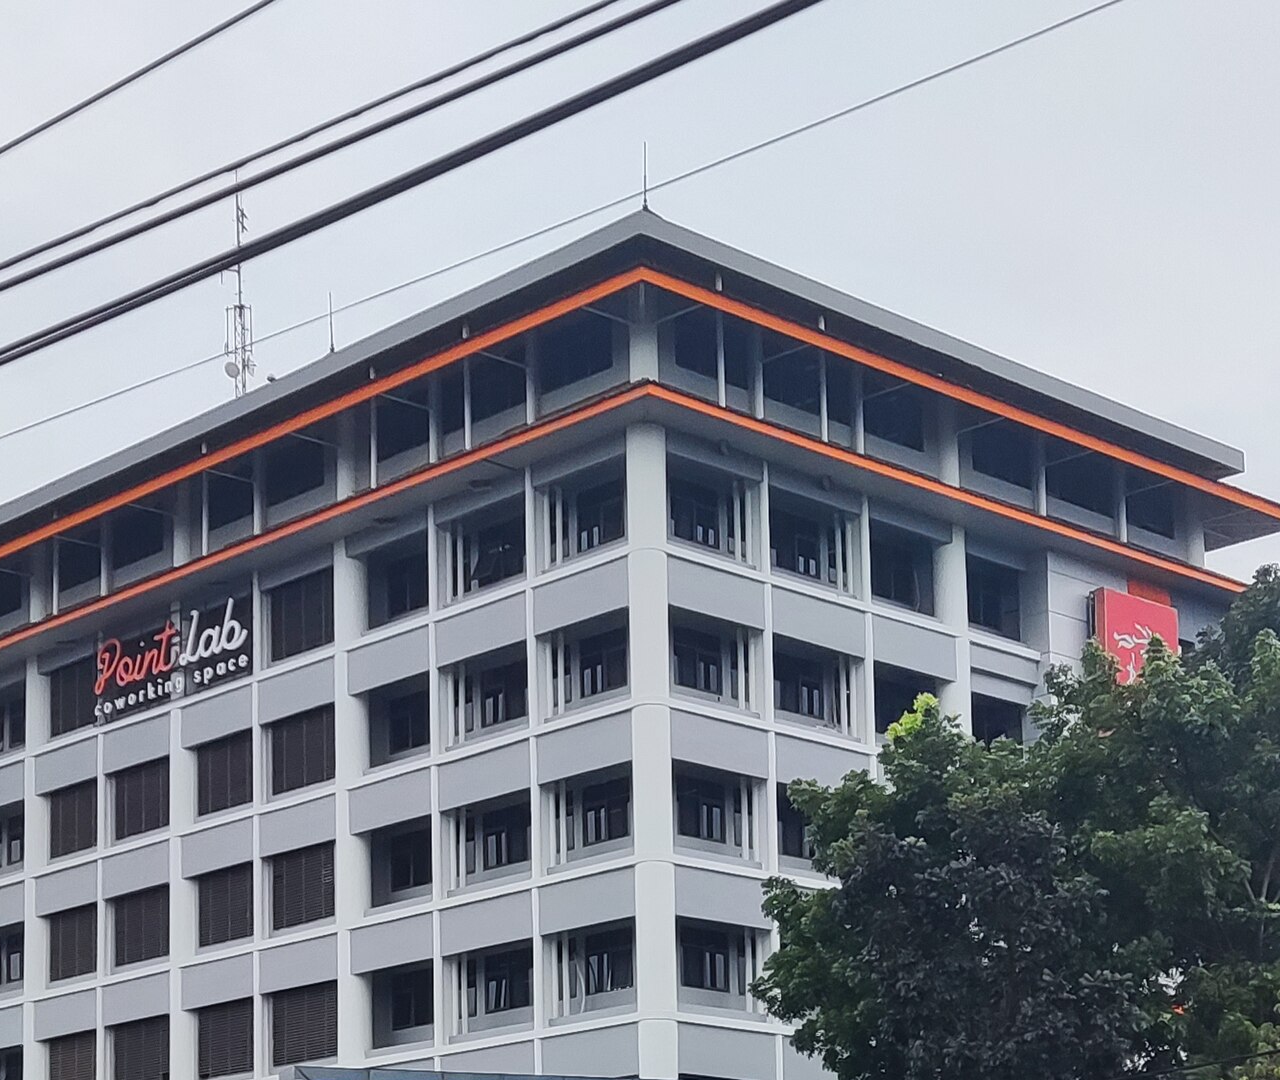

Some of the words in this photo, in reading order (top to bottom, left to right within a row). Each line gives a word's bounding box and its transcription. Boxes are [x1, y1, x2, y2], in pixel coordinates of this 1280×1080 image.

[94, 620, 179, 695] Point
[94, 676, 185, 716] coworking
[193, 654, 249, 684] space
